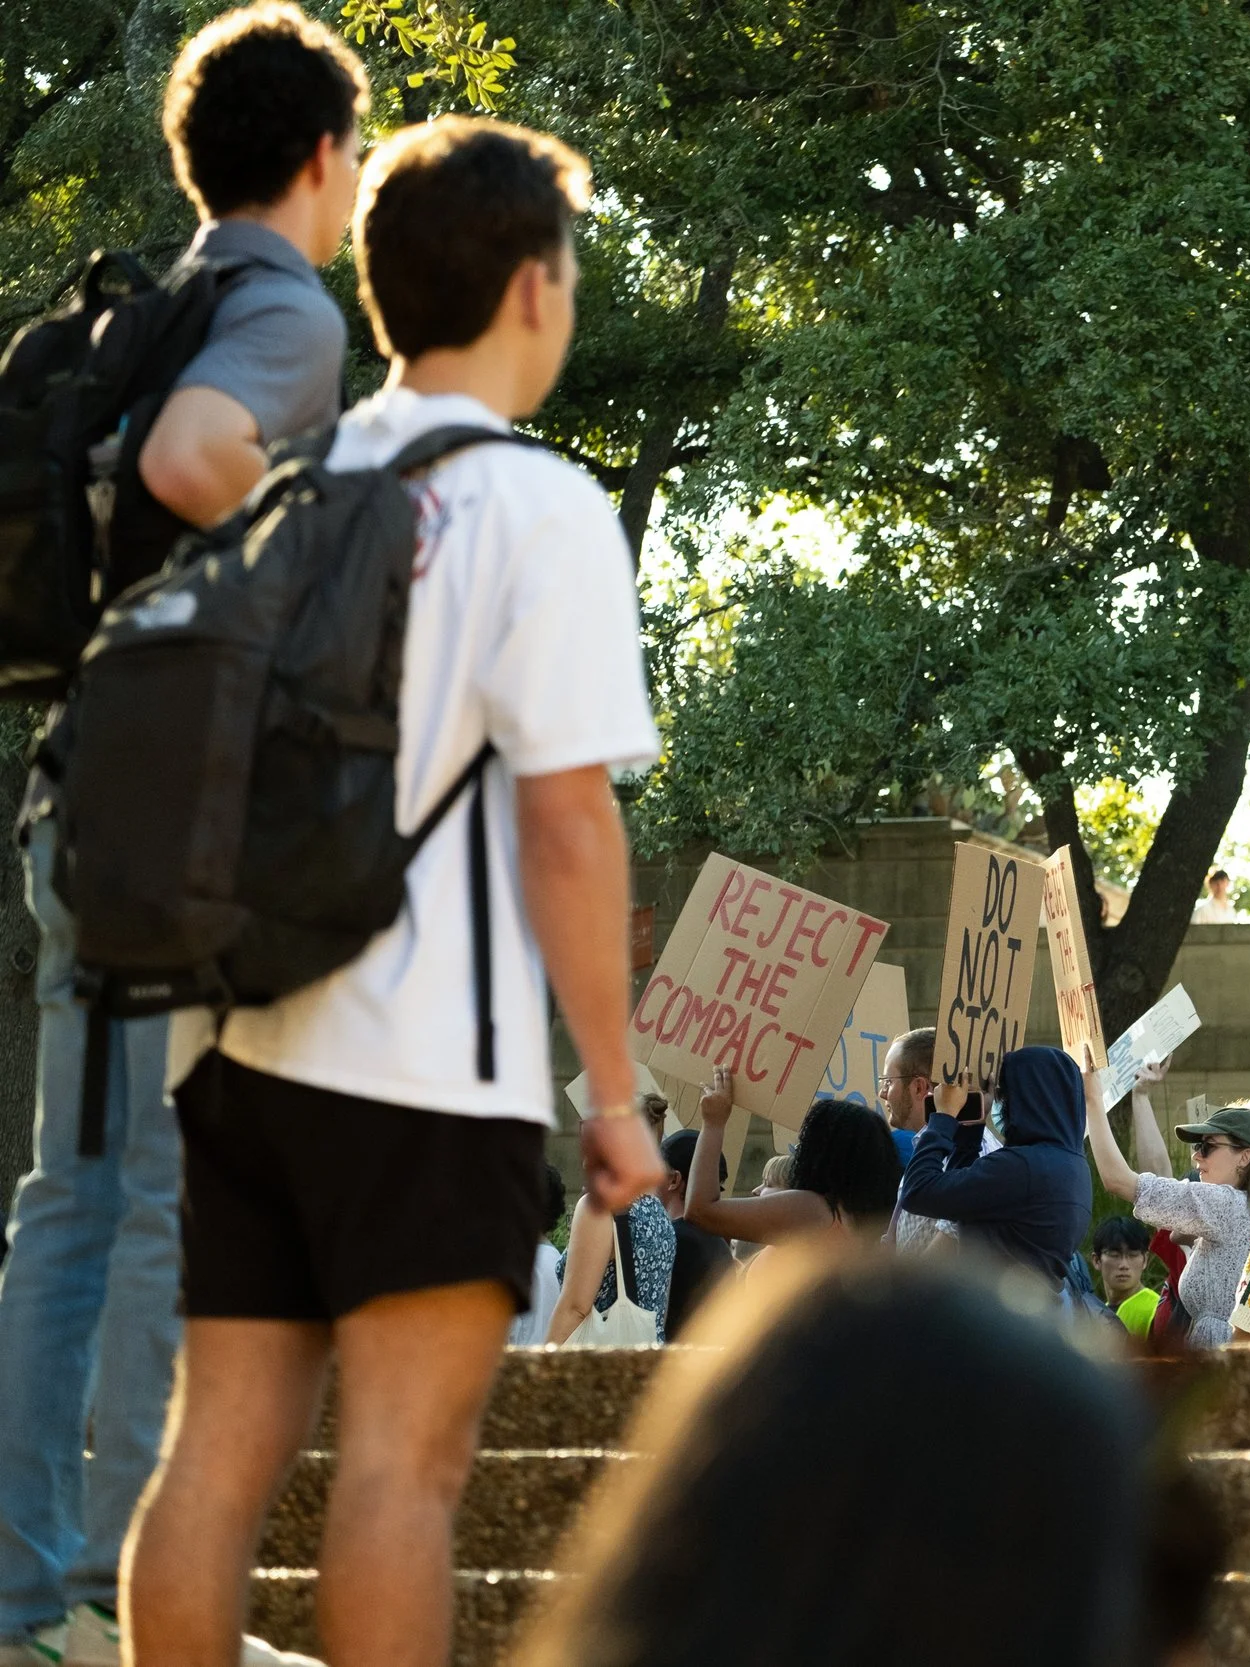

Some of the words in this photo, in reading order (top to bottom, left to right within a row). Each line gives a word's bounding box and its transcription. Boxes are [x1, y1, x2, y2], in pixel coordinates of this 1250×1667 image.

[708, 869, 887, 977] REJECT
[982, 854, 1018, 934] DO
[716, 947, 798, 1017] THE
[957, 927, 1022, 1012] NOT
[634, 974, 816, 1096] COMPACT
